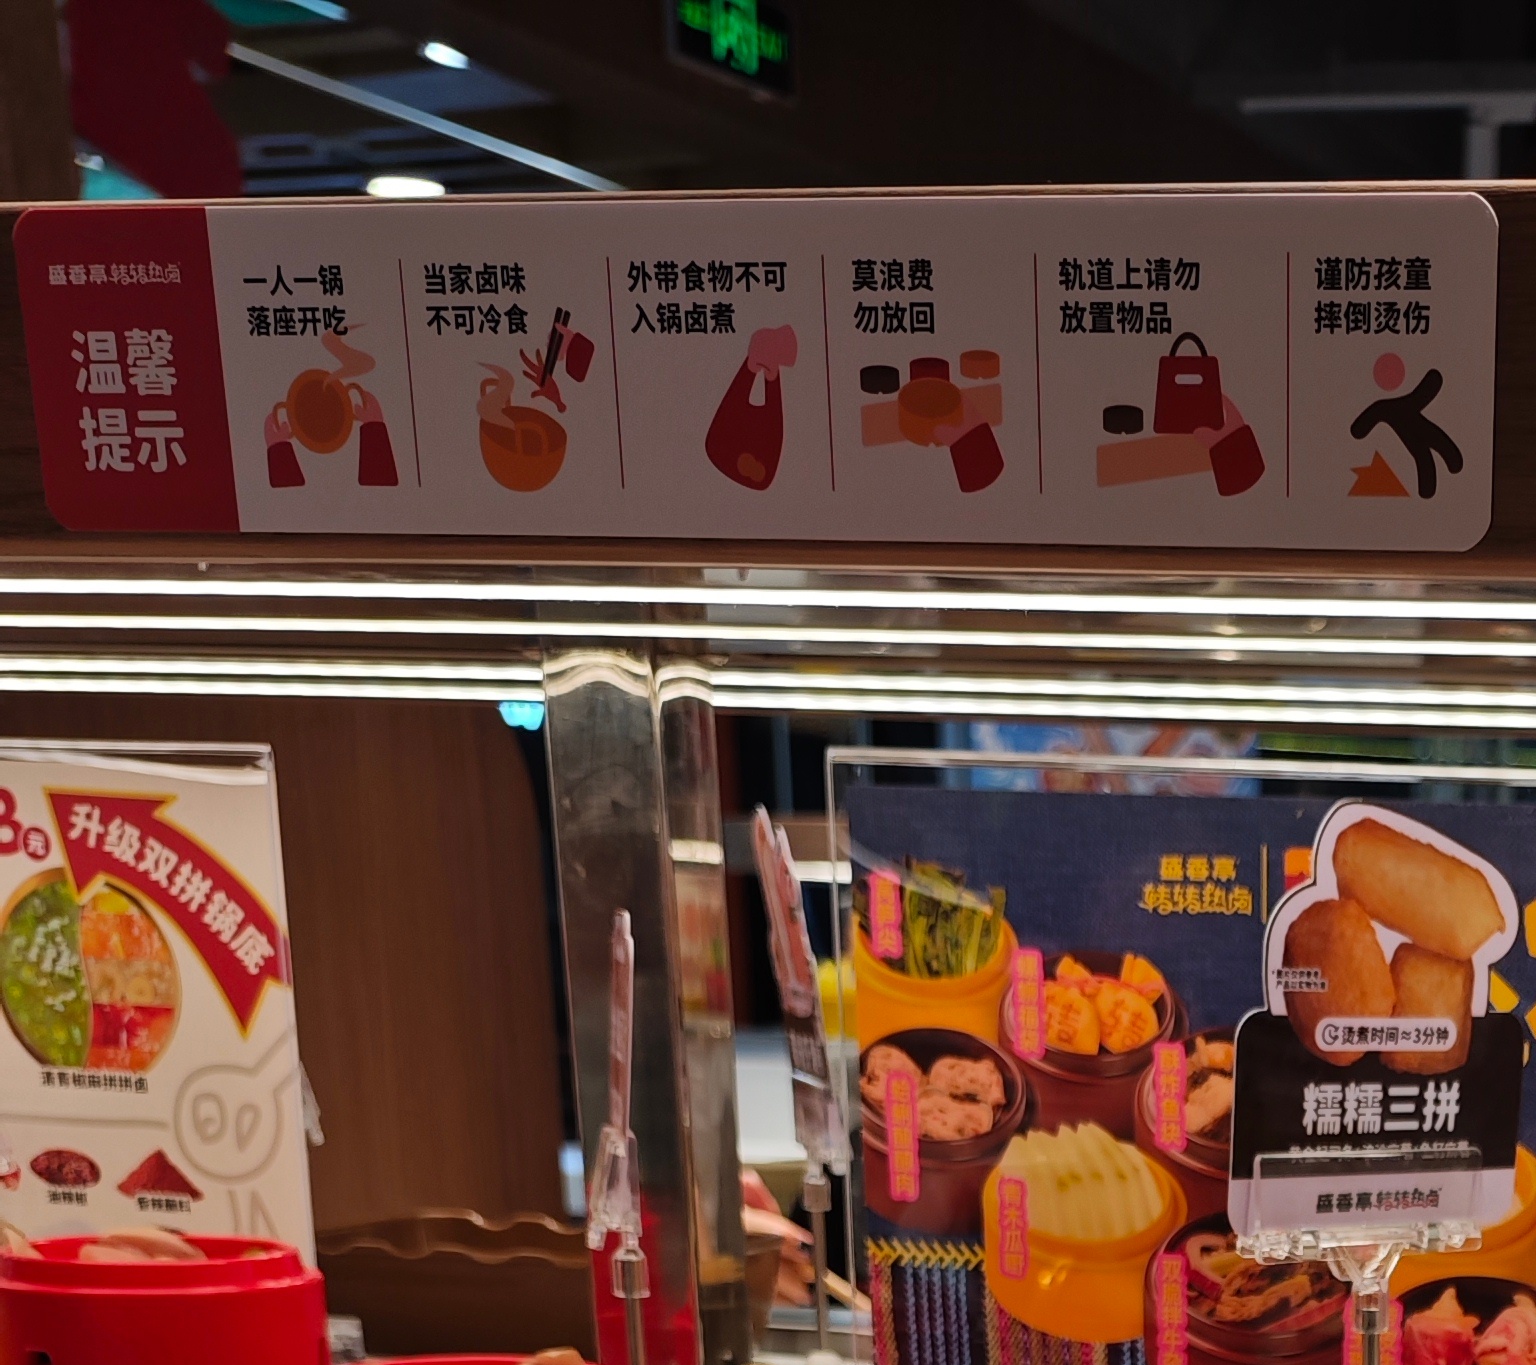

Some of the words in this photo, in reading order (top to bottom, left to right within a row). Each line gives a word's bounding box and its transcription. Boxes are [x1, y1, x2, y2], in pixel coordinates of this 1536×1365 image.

[242, 264, 345, 297] 一人一锅
[423, 262, 527, 295] 当家卤味
[627, 259, 787, 294] 外带食物不可
[851, 258, 934, 292] 莫浪费
[1058, 257, 1200, 292] 轨道上请勿
[1314, 256, 1432, 292] 谨防孩童
[247, 304, 348, 337] 落座开吃
[426, 303, 529, 336] 不可冷食
[631, 301, 737, 335] 入锅卤煮
[854, 301, 936, 335] 勿放回
[1059, 301, 1173, 335] 放置物品
[1313, 301, 1431, 336] 摔倒烫伤
[70, 328, 178, 396] 温馨
[79, 407, 187, 474] 提示
[68, 803, 276, 975] 升级双拼锅底
[1302, 1081, 1461, 1135] 糯糯三拼
